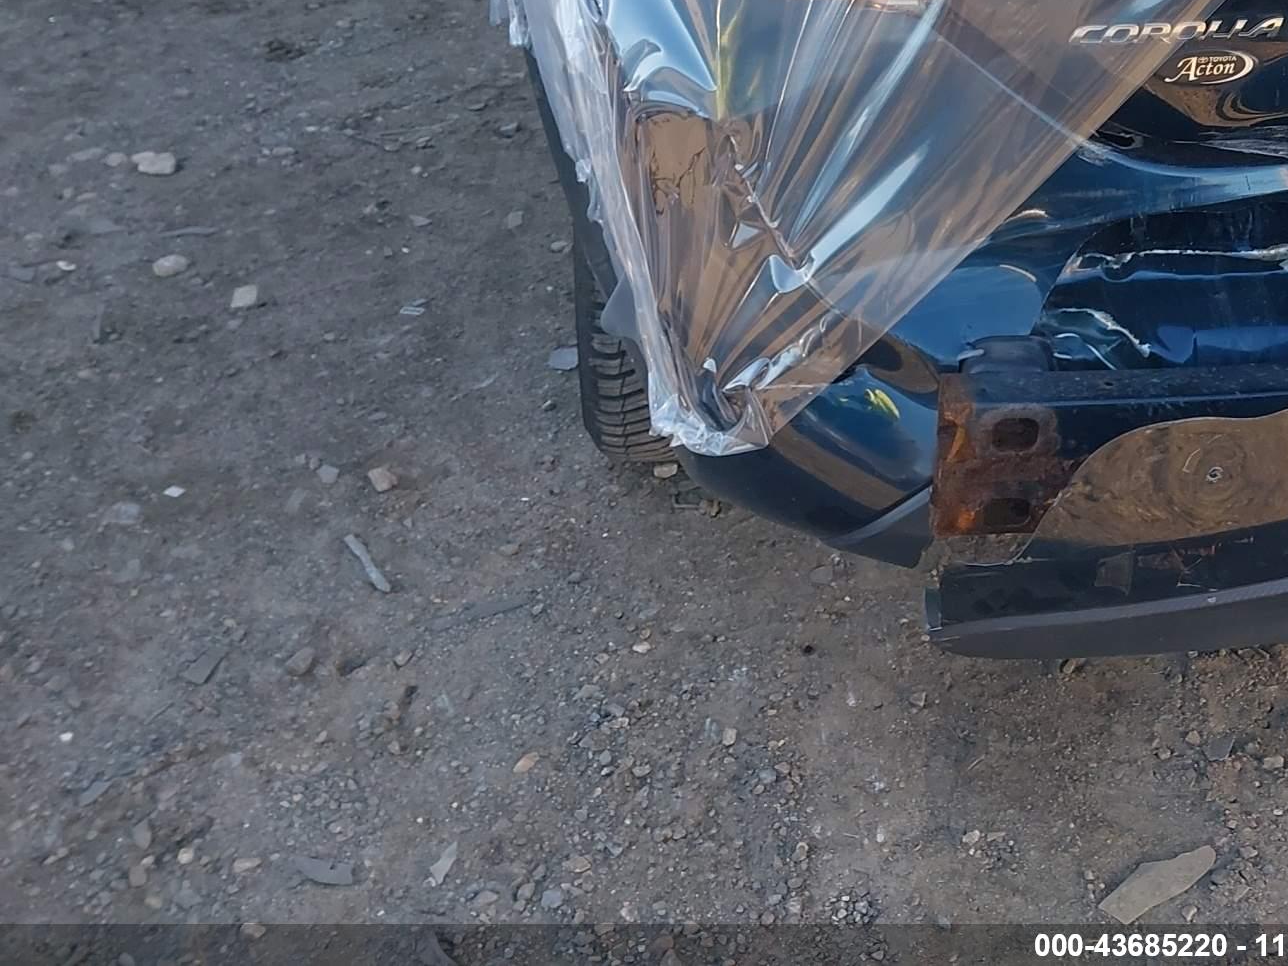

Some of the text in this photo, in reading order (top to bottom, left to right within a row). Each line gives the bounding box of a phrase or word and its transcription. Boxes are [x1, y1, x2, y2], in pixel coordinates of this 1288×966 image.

[1068, 17, 1285, 44] COROLLA
[1164, 56, 1235, 82] Acton
[1209, 55, 1237, 63] TOYOTA
